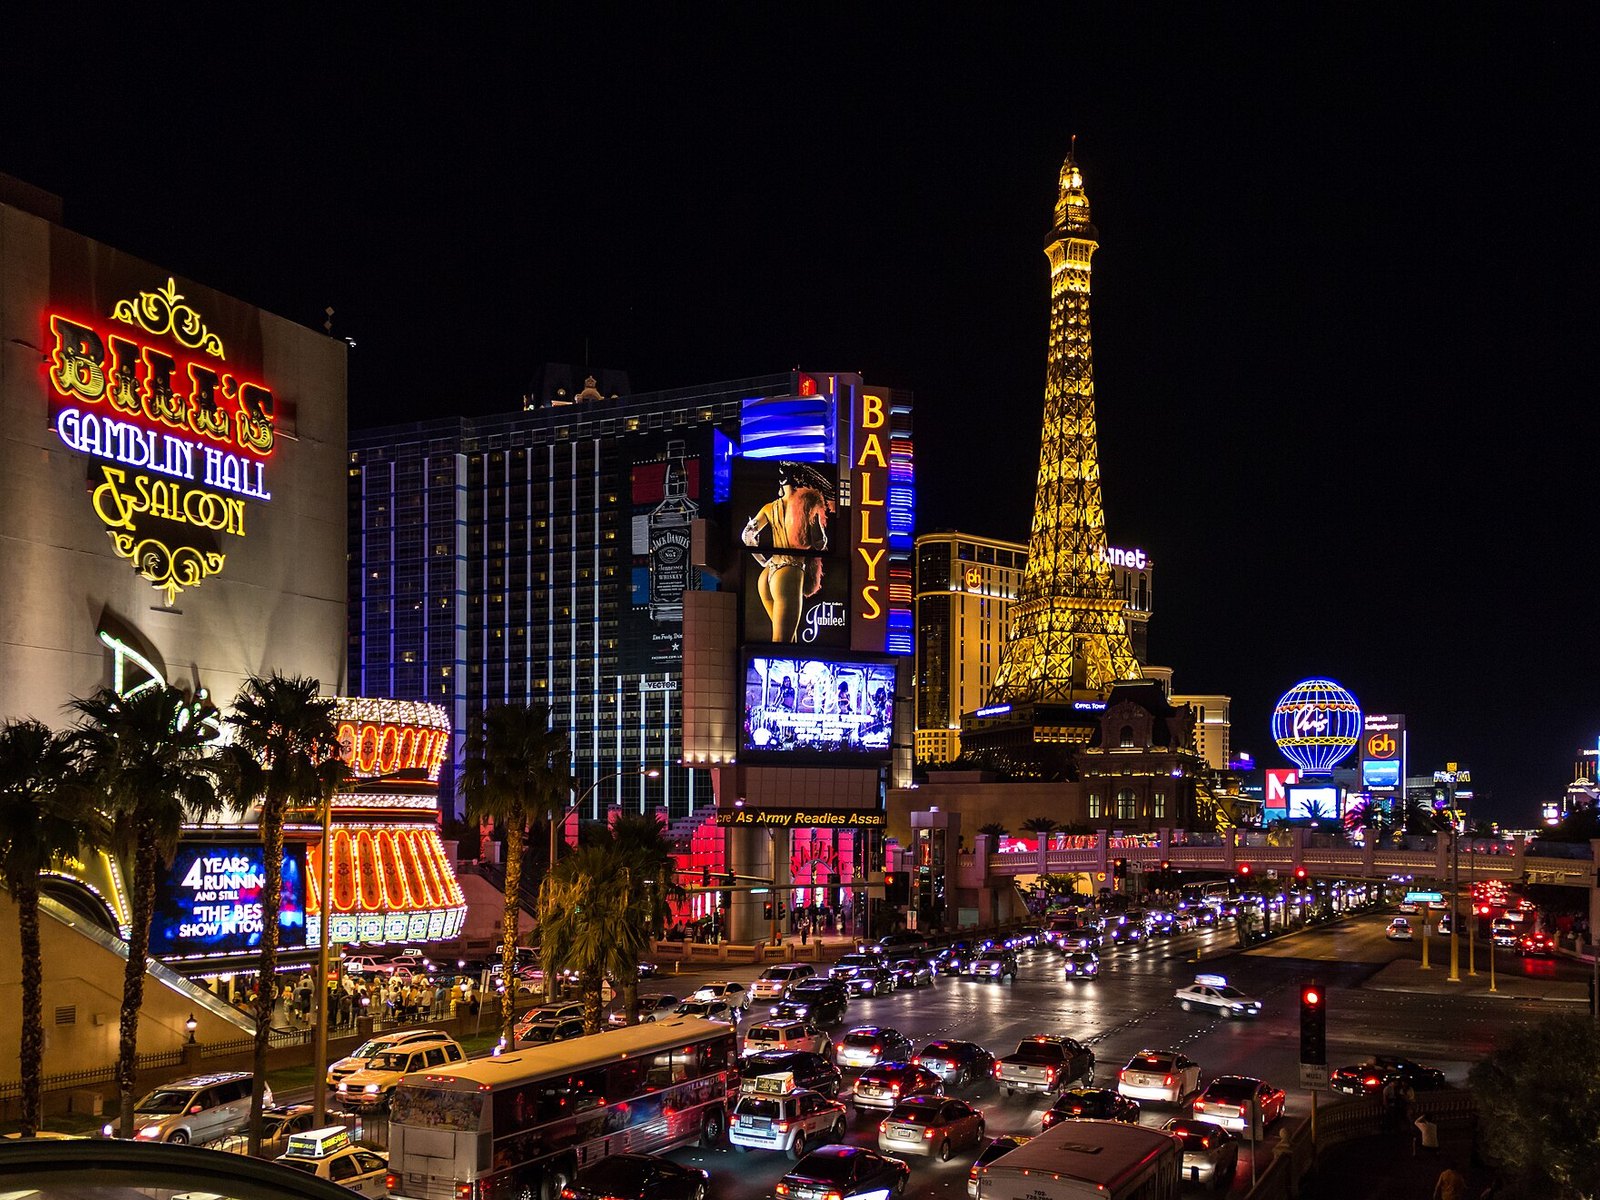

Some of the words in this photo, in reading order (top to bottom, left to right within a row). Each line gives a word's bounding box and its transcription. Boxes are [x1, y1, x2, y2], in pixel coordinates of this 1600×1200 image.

[49, 315, 275, 456] BILL'S
[57, 408, 204, 479] GAMBLIN'
[204, 446, 271, 500] HALL
[92, 465, 136, 531] &
[134, 476, 246, 537] SALOON
[857, 394, 888, 621] BALLYS
[652, 535, 667, 552] JACK
[666, 532, 691, 549] DANIEL'S
[802, 603, 846, 643] Jubilee!
[1371, 734, 1396, 754] ph
[1433, 770, 1471, 783] MGM
[736, 811, 753, 823] As
[756, 812, 792, 826] Army
[795, 812, 845, 825] Readies
[181, 857, 203, 890] 4
[203, 857, 249, 873] YEARS
[204, 873, 265, 890] RUNNIN
[194, 891, 217, 902] AND
[219, 890, 239, 900] STILL
[234, 903, 263, 921] BES
[179, 922, 220, 937] SHOW
[222, 921, 236, 935] IN
[238, 919, 264, 933] TOW
